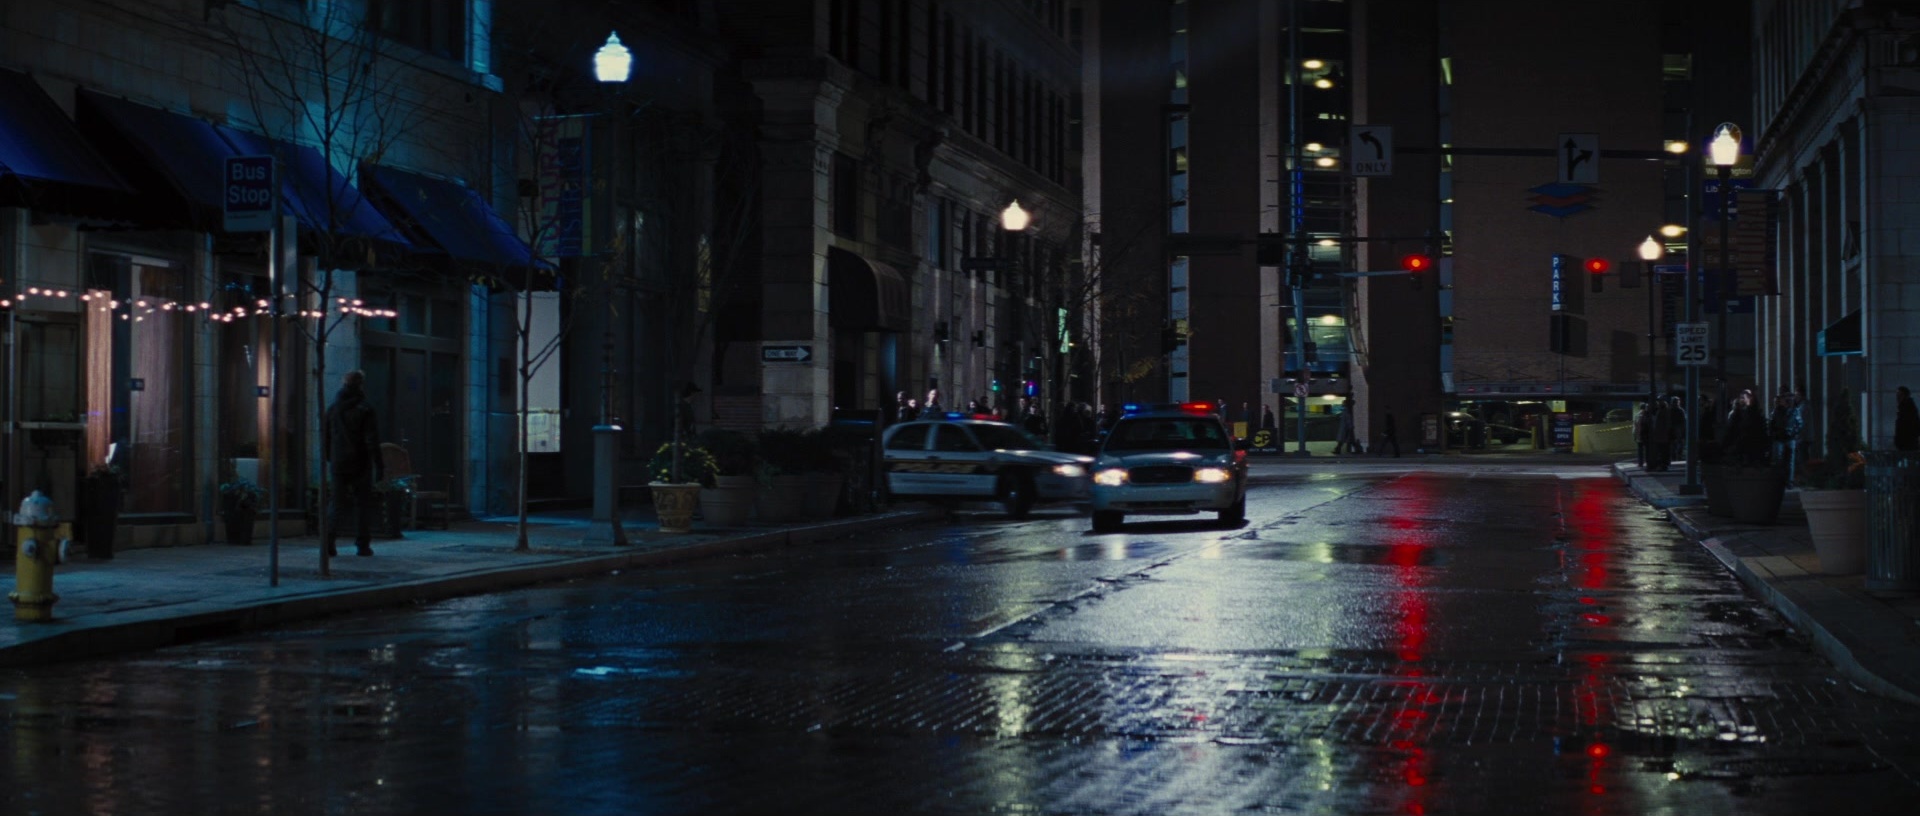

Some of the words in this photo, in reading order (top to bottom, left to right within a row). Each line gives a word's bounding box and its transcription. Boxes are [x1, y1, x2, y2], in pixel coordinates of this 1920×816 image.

[232, 162, 266, 180] Bus
[1356, 162, 1387, 173] ONLY
[229, 184, 270, 207] Stop
[1552, 257, 1560, 303] PARK
[1678, 327, 1706, 335] SPEED
[1680, 336, 1704, 344] LIMIT
[1679, 345, 1706, 361] 25
[1253, 432, 1271, 445] CP
